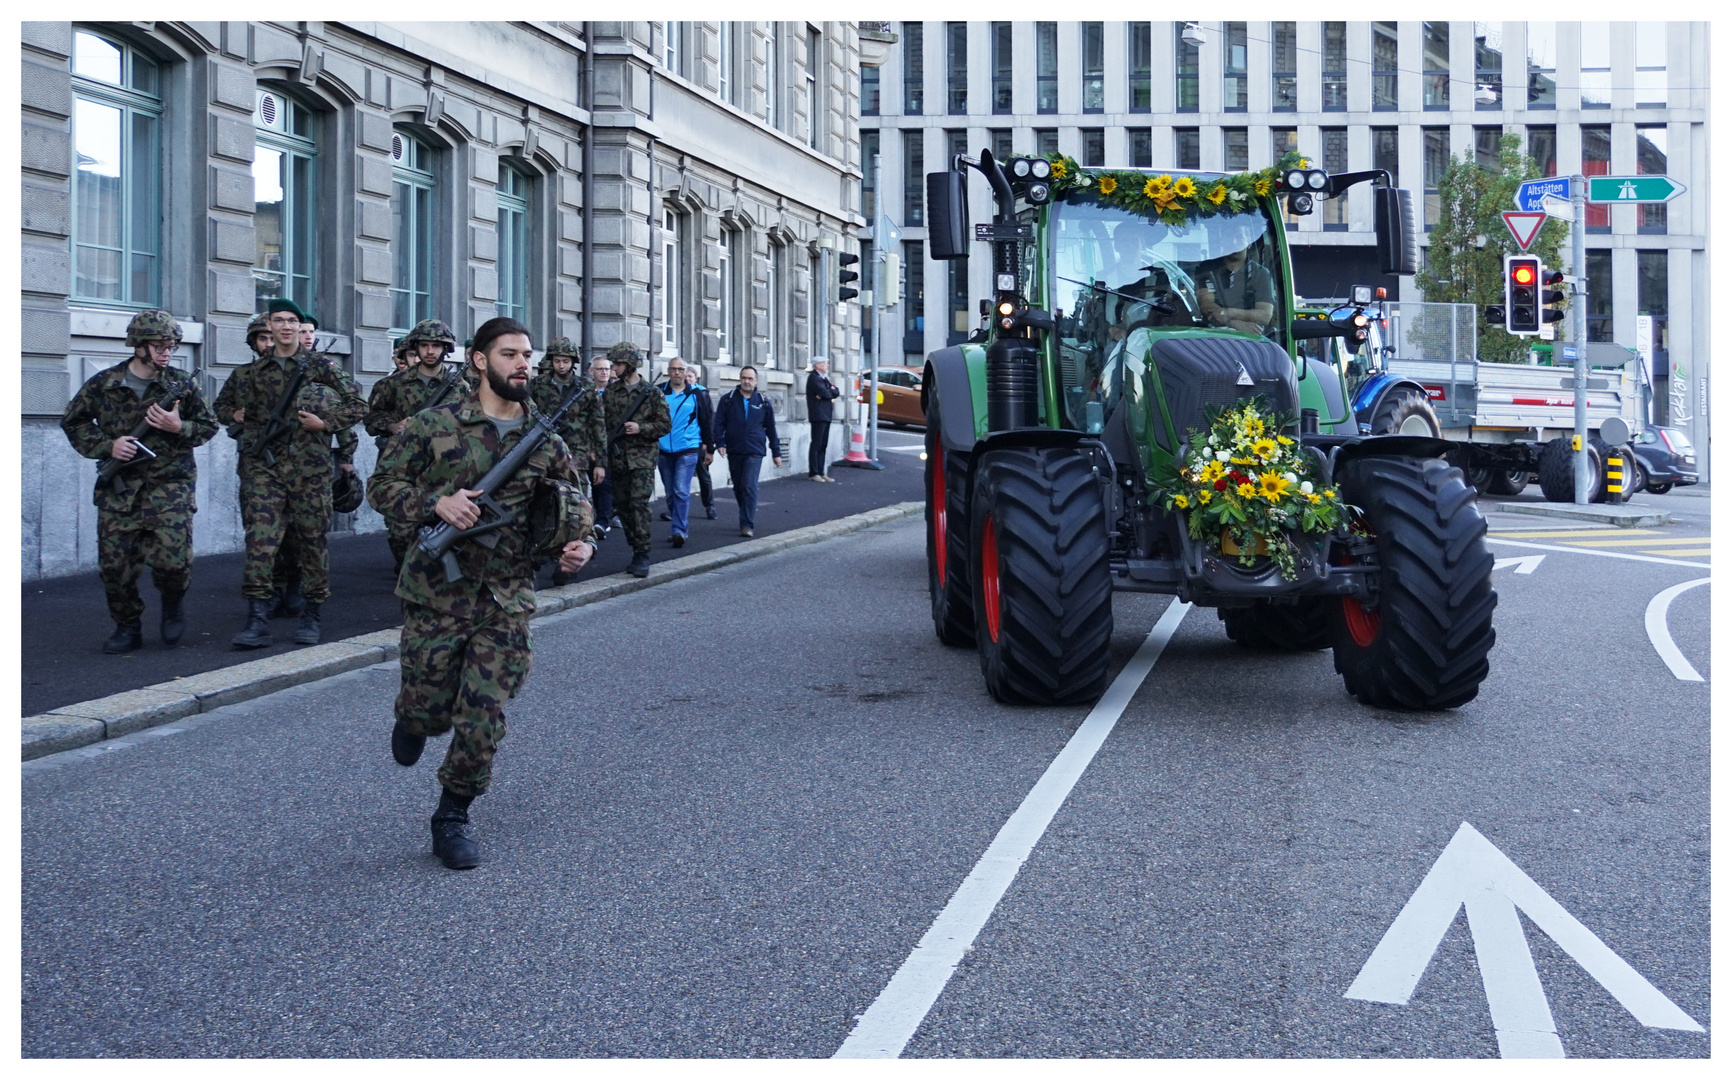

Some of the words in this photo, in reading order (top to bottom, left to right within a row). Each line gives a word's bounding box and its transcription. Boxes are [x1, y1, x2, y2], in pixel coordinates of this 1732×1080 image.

[1527, 183, 1563, 196] Altstätten
[1639, 319, 1647, 329] 18
[1639, 344, 1647, 354] 16
[1425, 389, 1441, 397] rar
